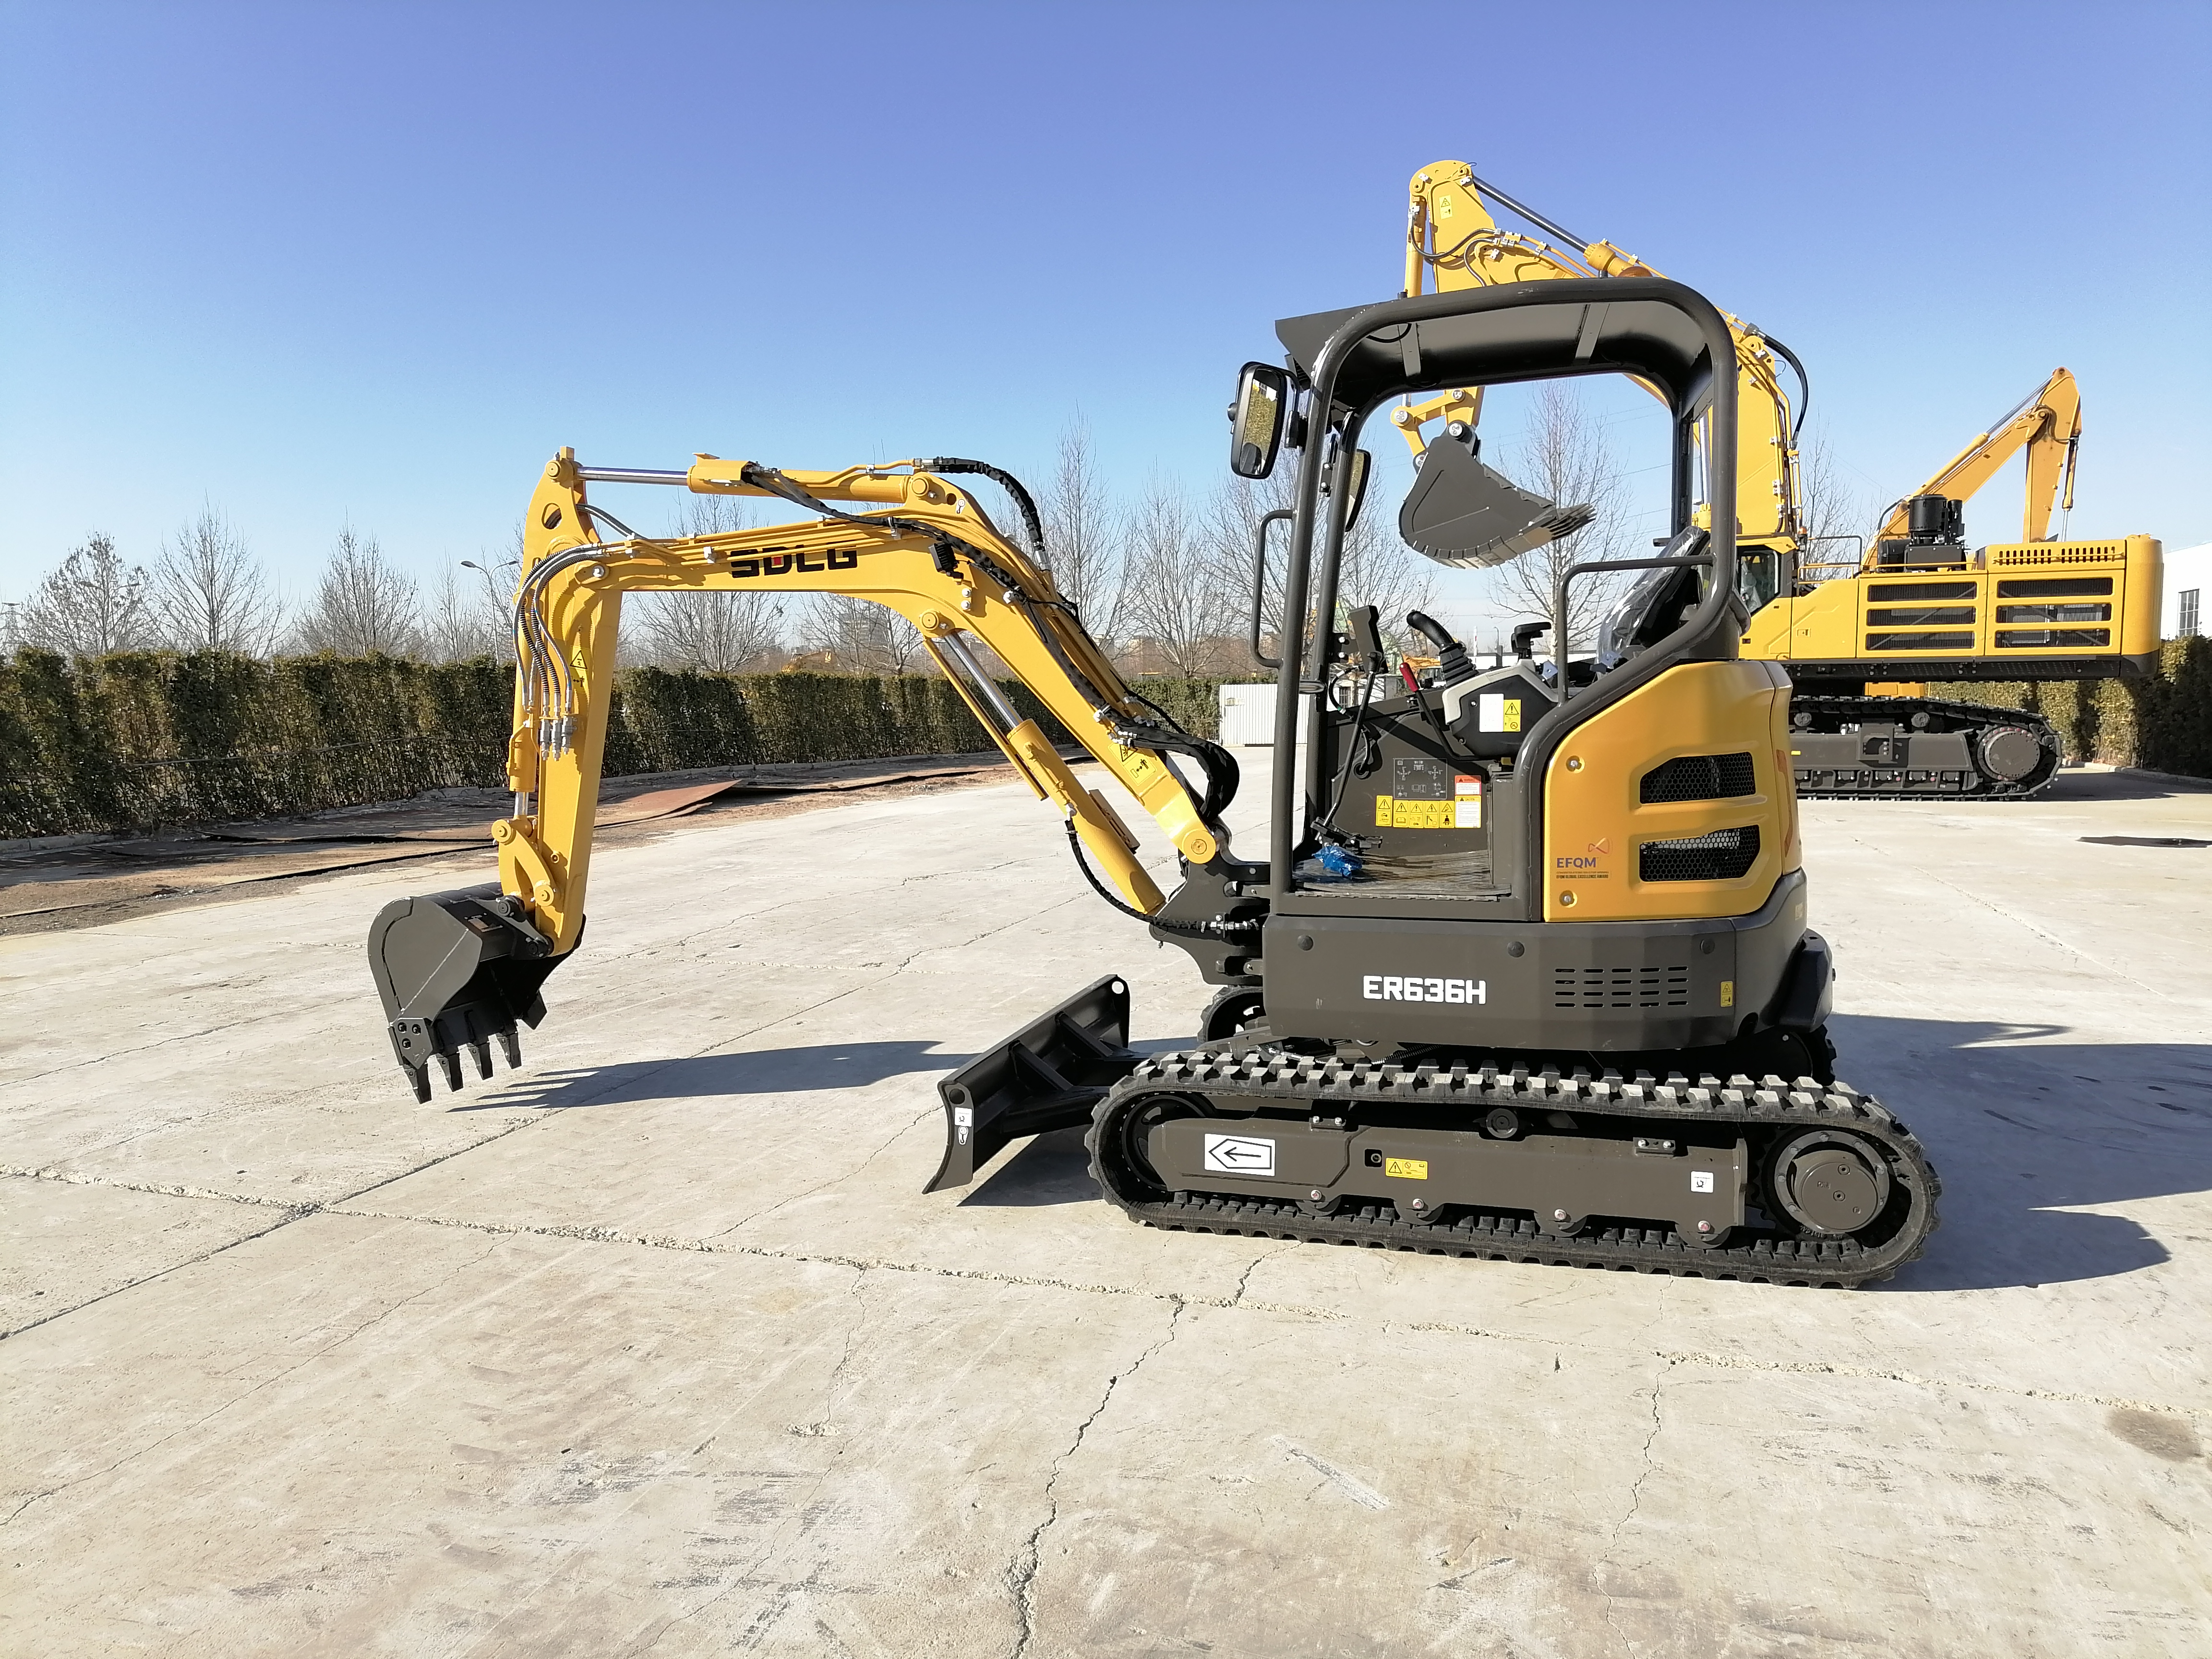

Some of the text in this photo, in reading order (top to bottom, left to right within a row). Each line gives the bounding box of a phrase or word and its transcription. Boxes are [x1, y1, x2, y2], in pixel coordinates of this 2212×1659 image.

[731, 540, 858, 578] SDLG
[1557, 857, 1597, 869] EFQM
[1363, 975, 1486, 1004] ER636H
